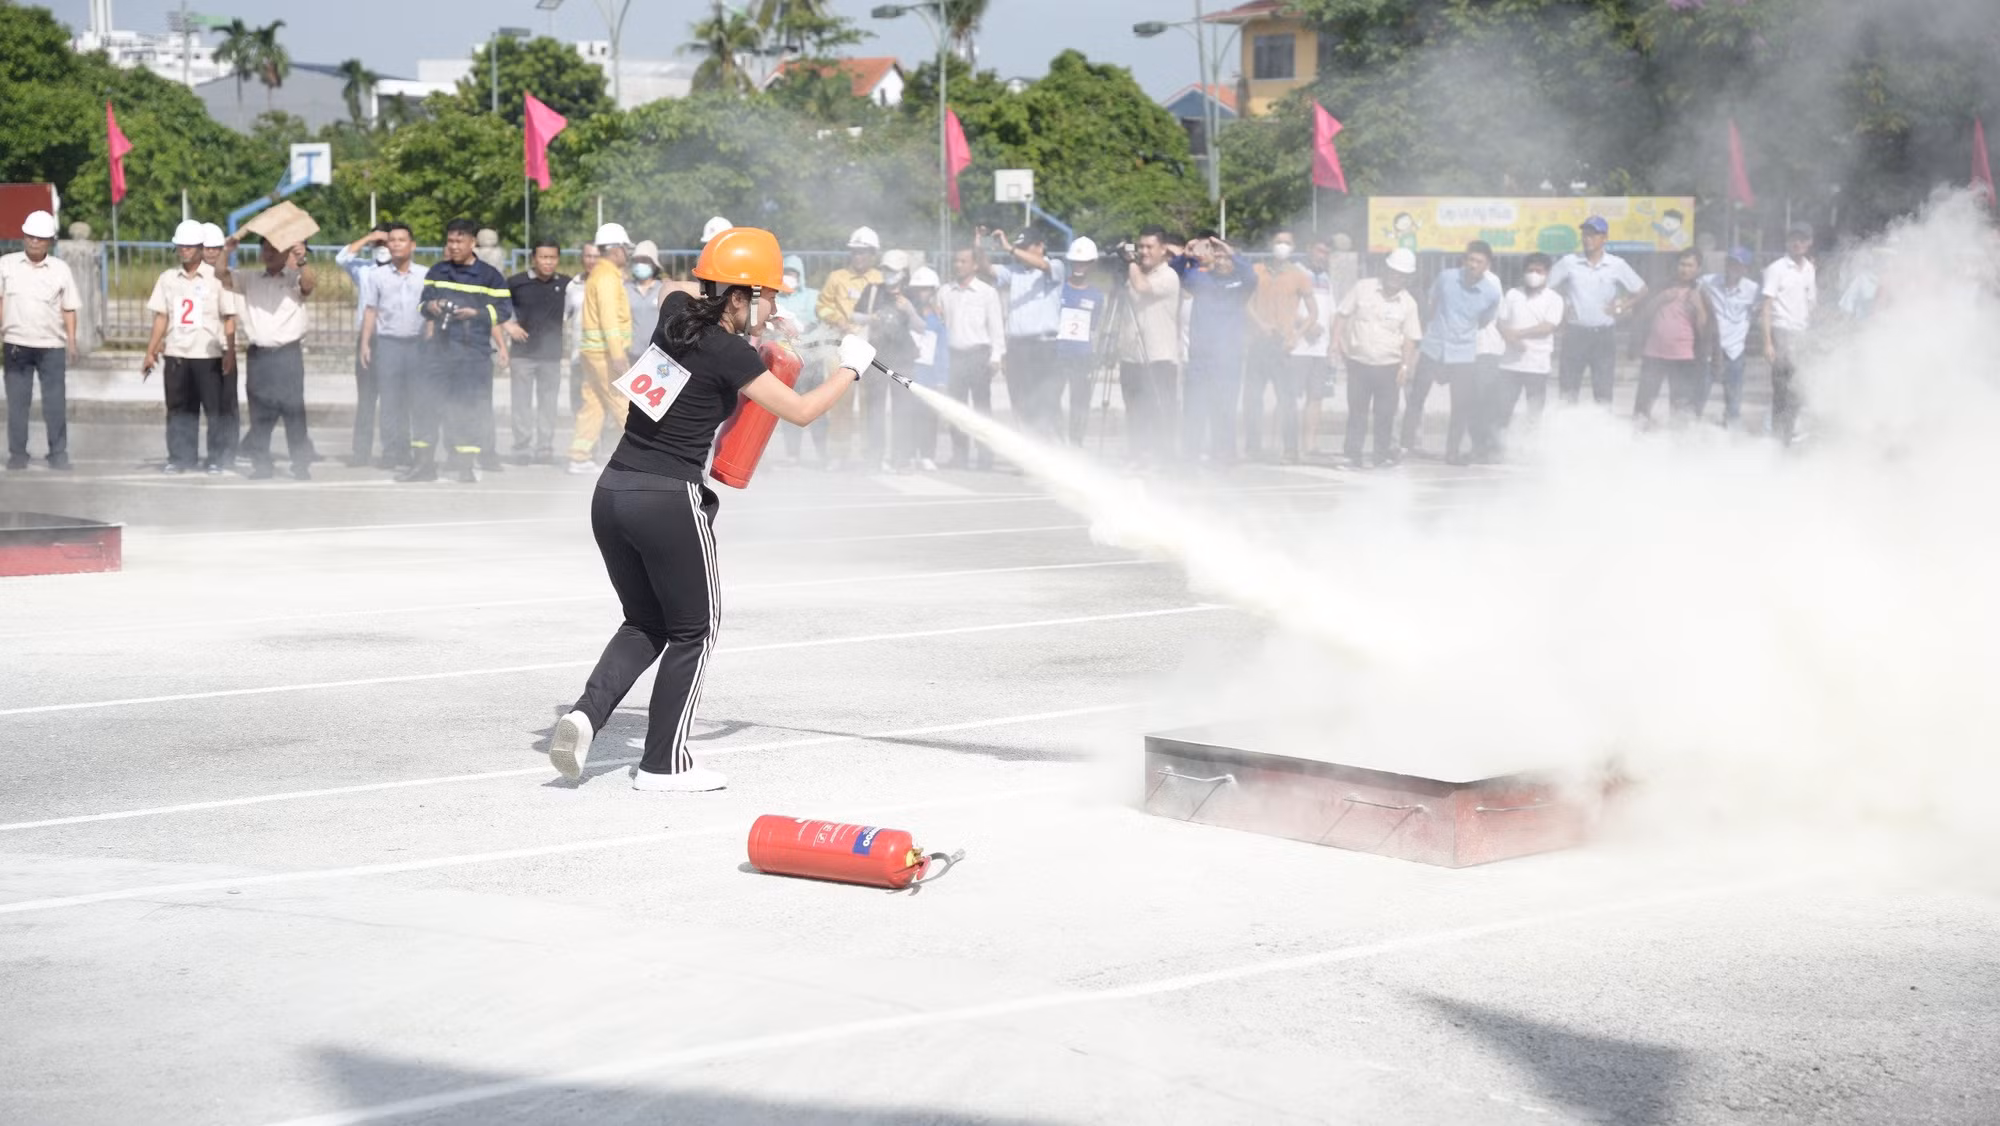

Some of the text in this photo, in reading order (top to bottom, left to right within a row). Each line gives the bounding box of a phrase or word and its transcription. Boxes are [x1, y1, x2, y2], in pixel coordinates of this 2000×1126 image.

[181, 298, 194, 325] 2
[1070, 322, 1080, 336] 2
[630, 374, 667, 408] 04
